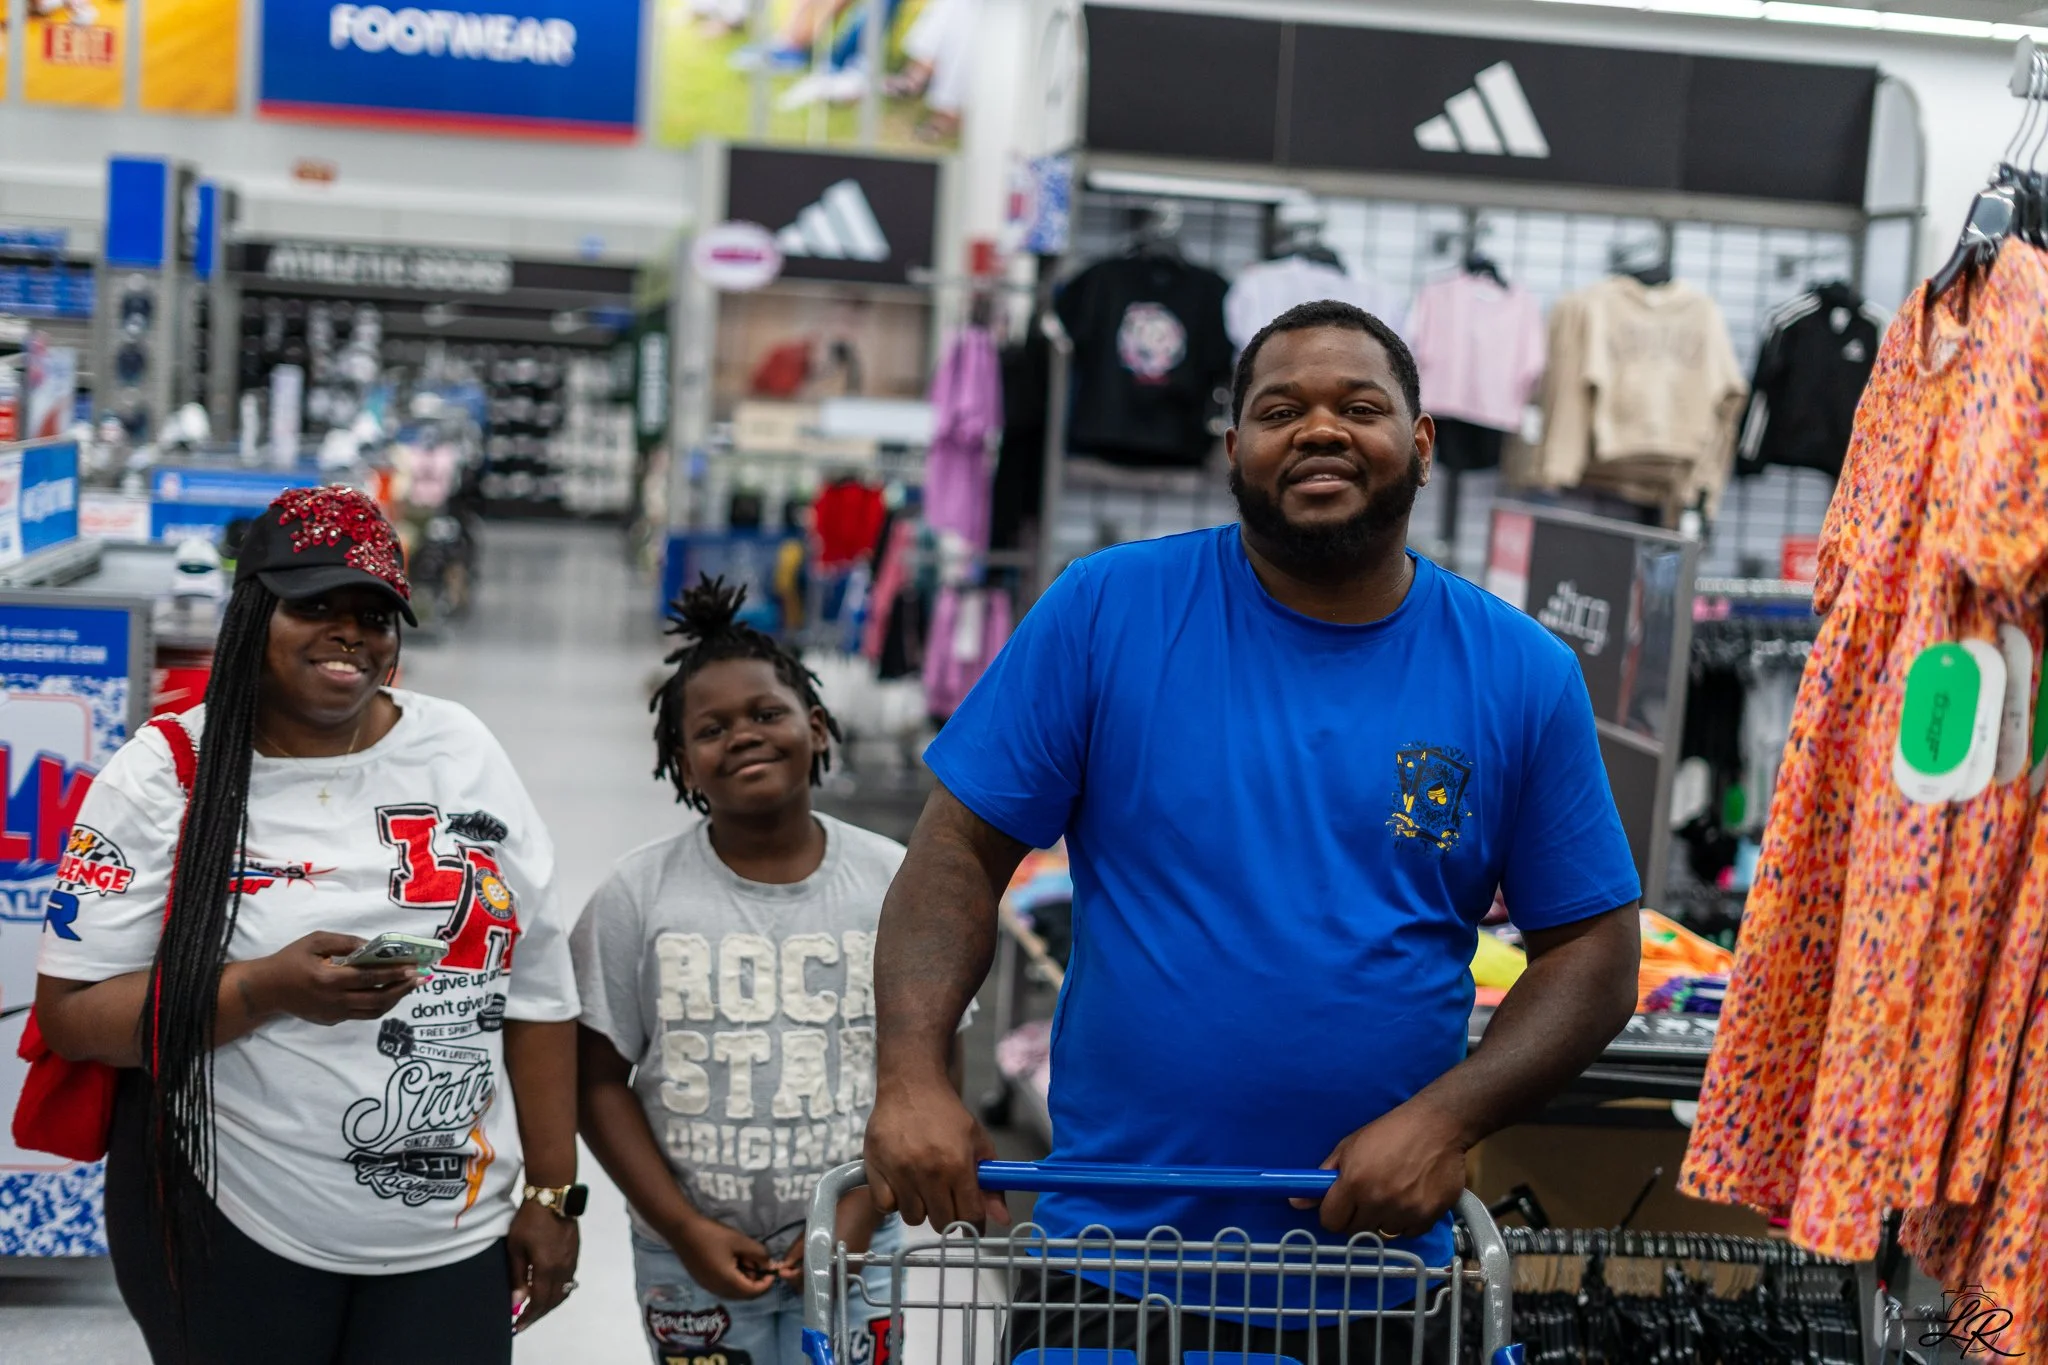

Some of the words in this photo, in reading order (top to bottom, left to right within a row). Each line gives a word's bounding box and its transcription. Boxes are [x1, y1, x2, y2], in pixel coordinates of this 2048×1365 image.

[329, 2, 578, 67] FOOTWEAR
[432, 974, 468, 995] give
[471, 972, 488, 988] up
[412, 1000, 454, 1019] don't
[420, 1026, 445, 1037] FREE
[448, 1023, 473, 1035] SPIRIT
[411, 1043, 447, 1058] ACTIVE
[342, 1060, 496, 1150] State
[403, 1135, 432, 1149] SINCE
[696, 1171, 755, 1201] ART
